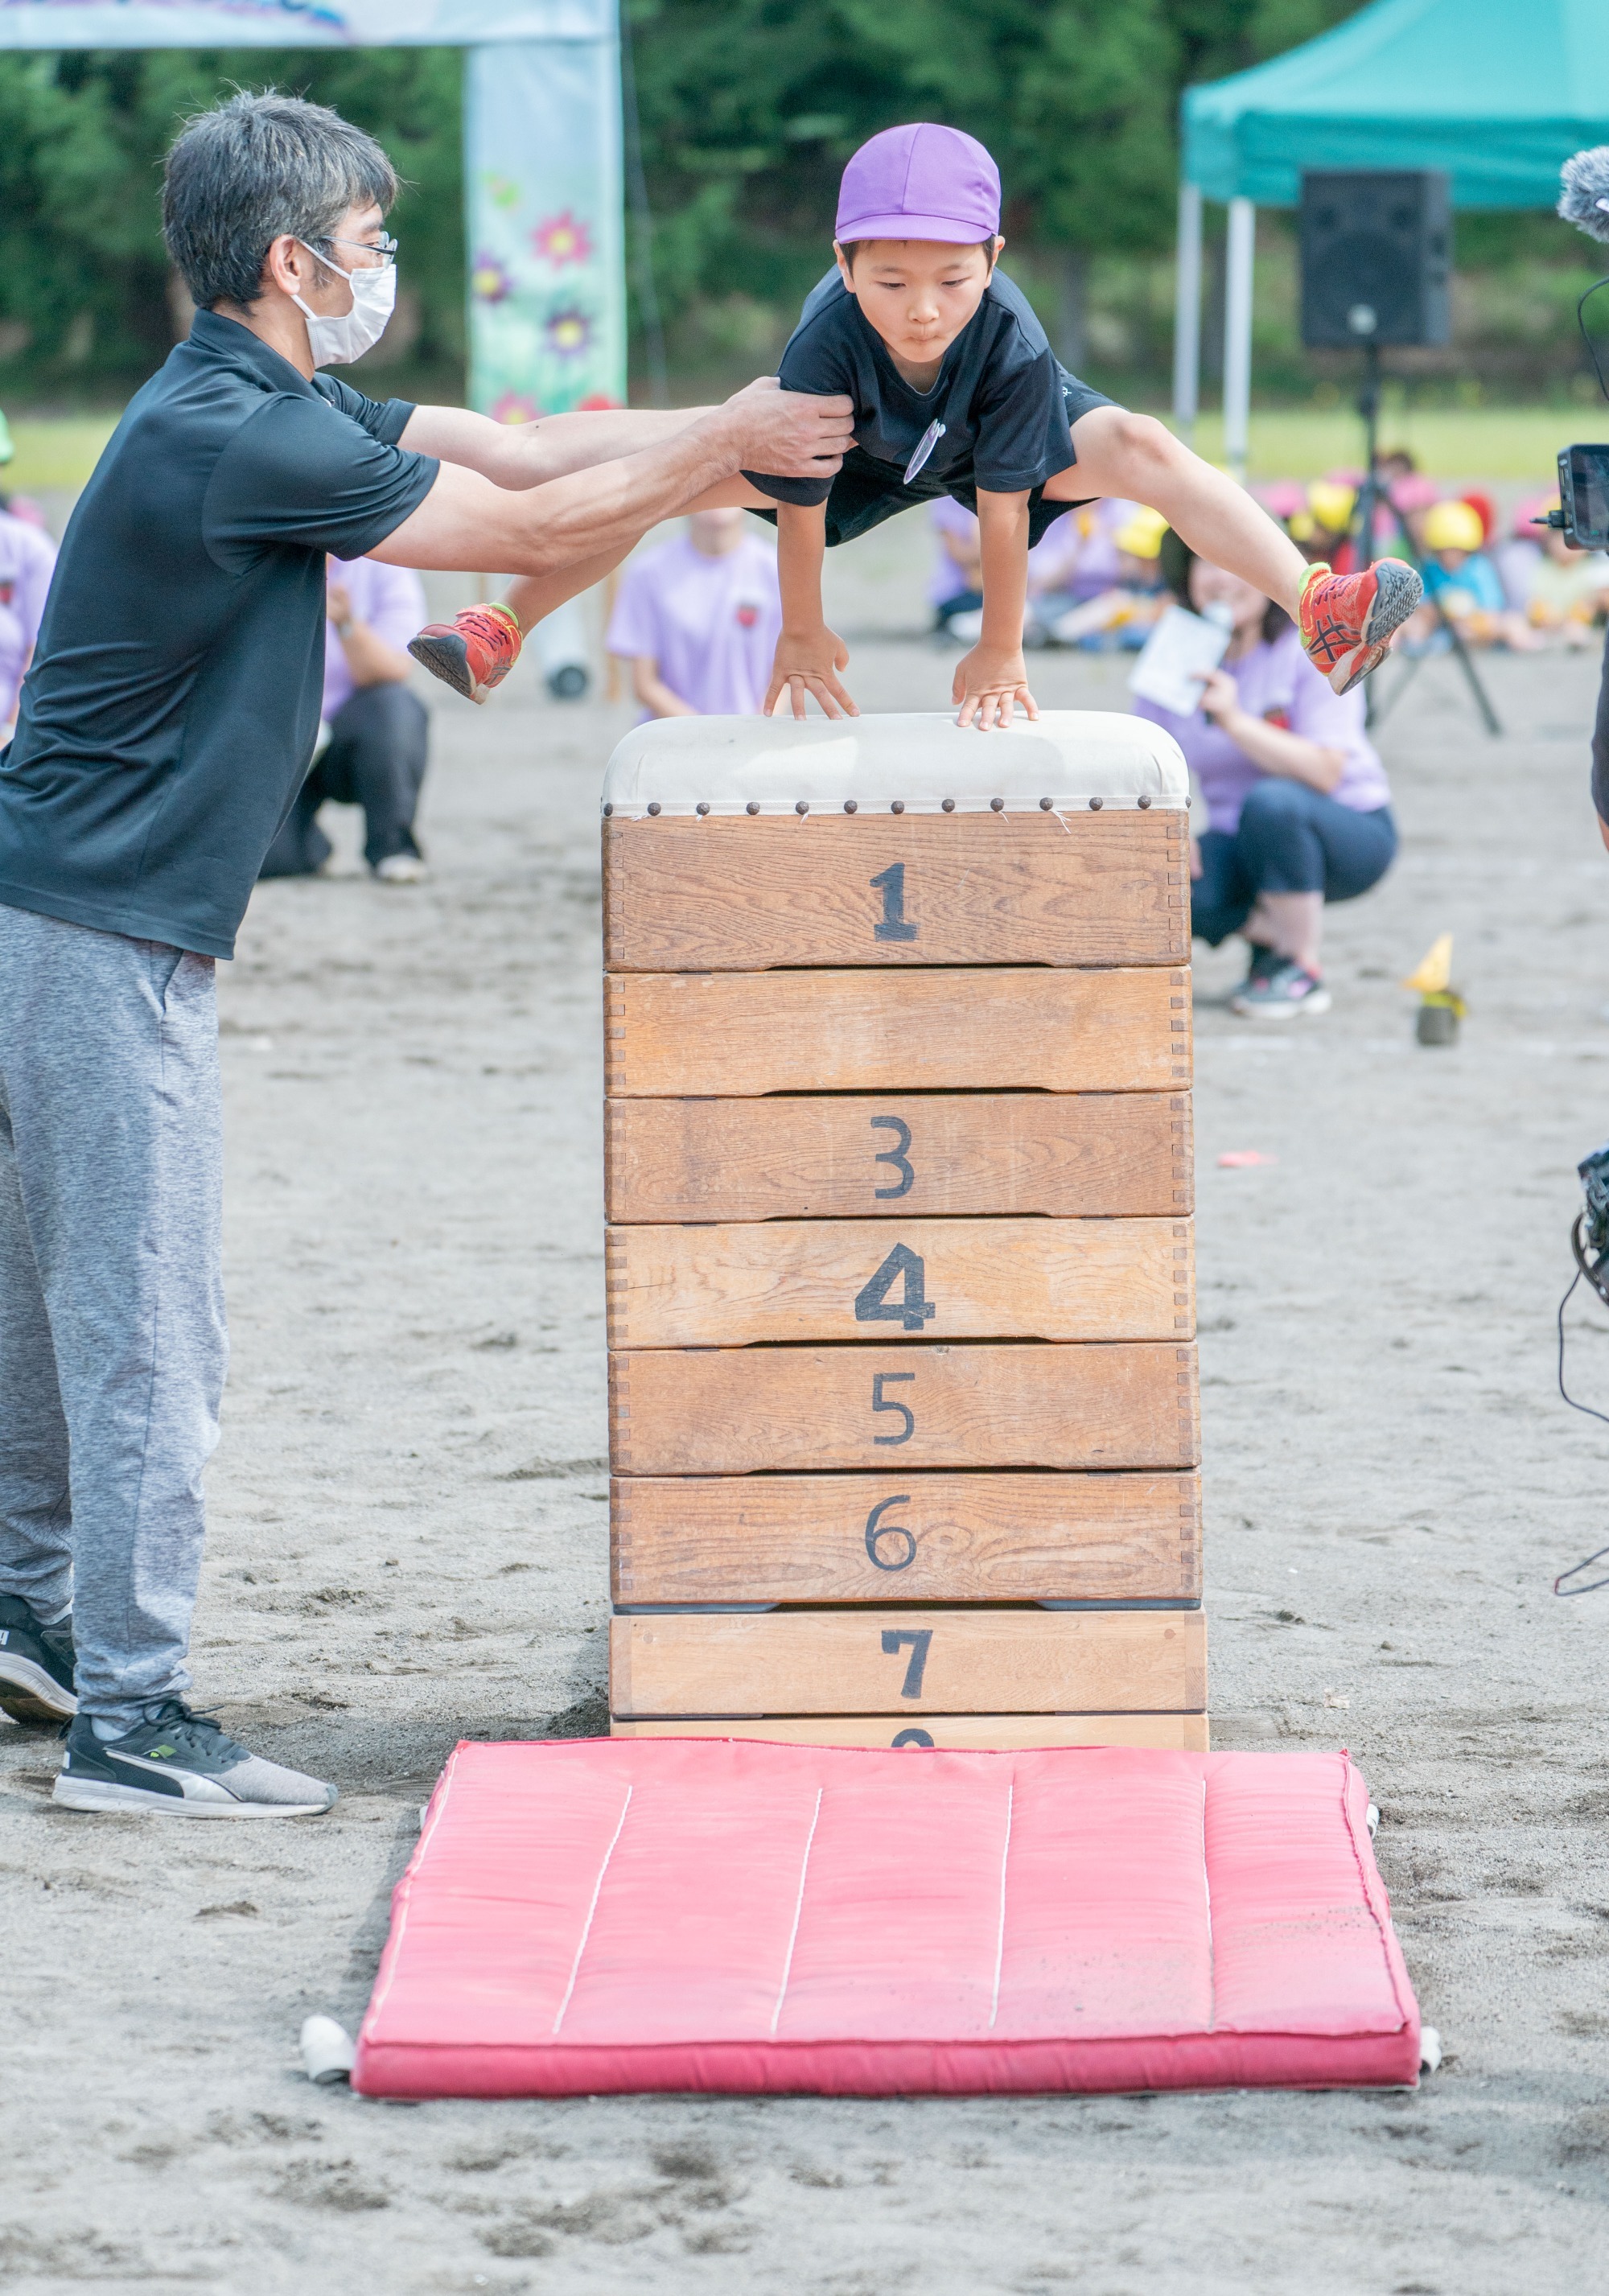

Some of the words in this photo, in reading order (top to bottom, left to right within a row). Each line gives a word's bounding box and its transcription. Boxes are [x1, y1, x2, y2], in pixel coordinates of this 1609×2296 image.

[870, 863, 917, 941] 1
[870, 1116, 915, 1199] 3
[854, 1242, 936, 1330] 4
[872, 1372, 915, 1445] 5
[865, 1496, 916, 1570] 6
[882, 1630, 933, 1698] 7
